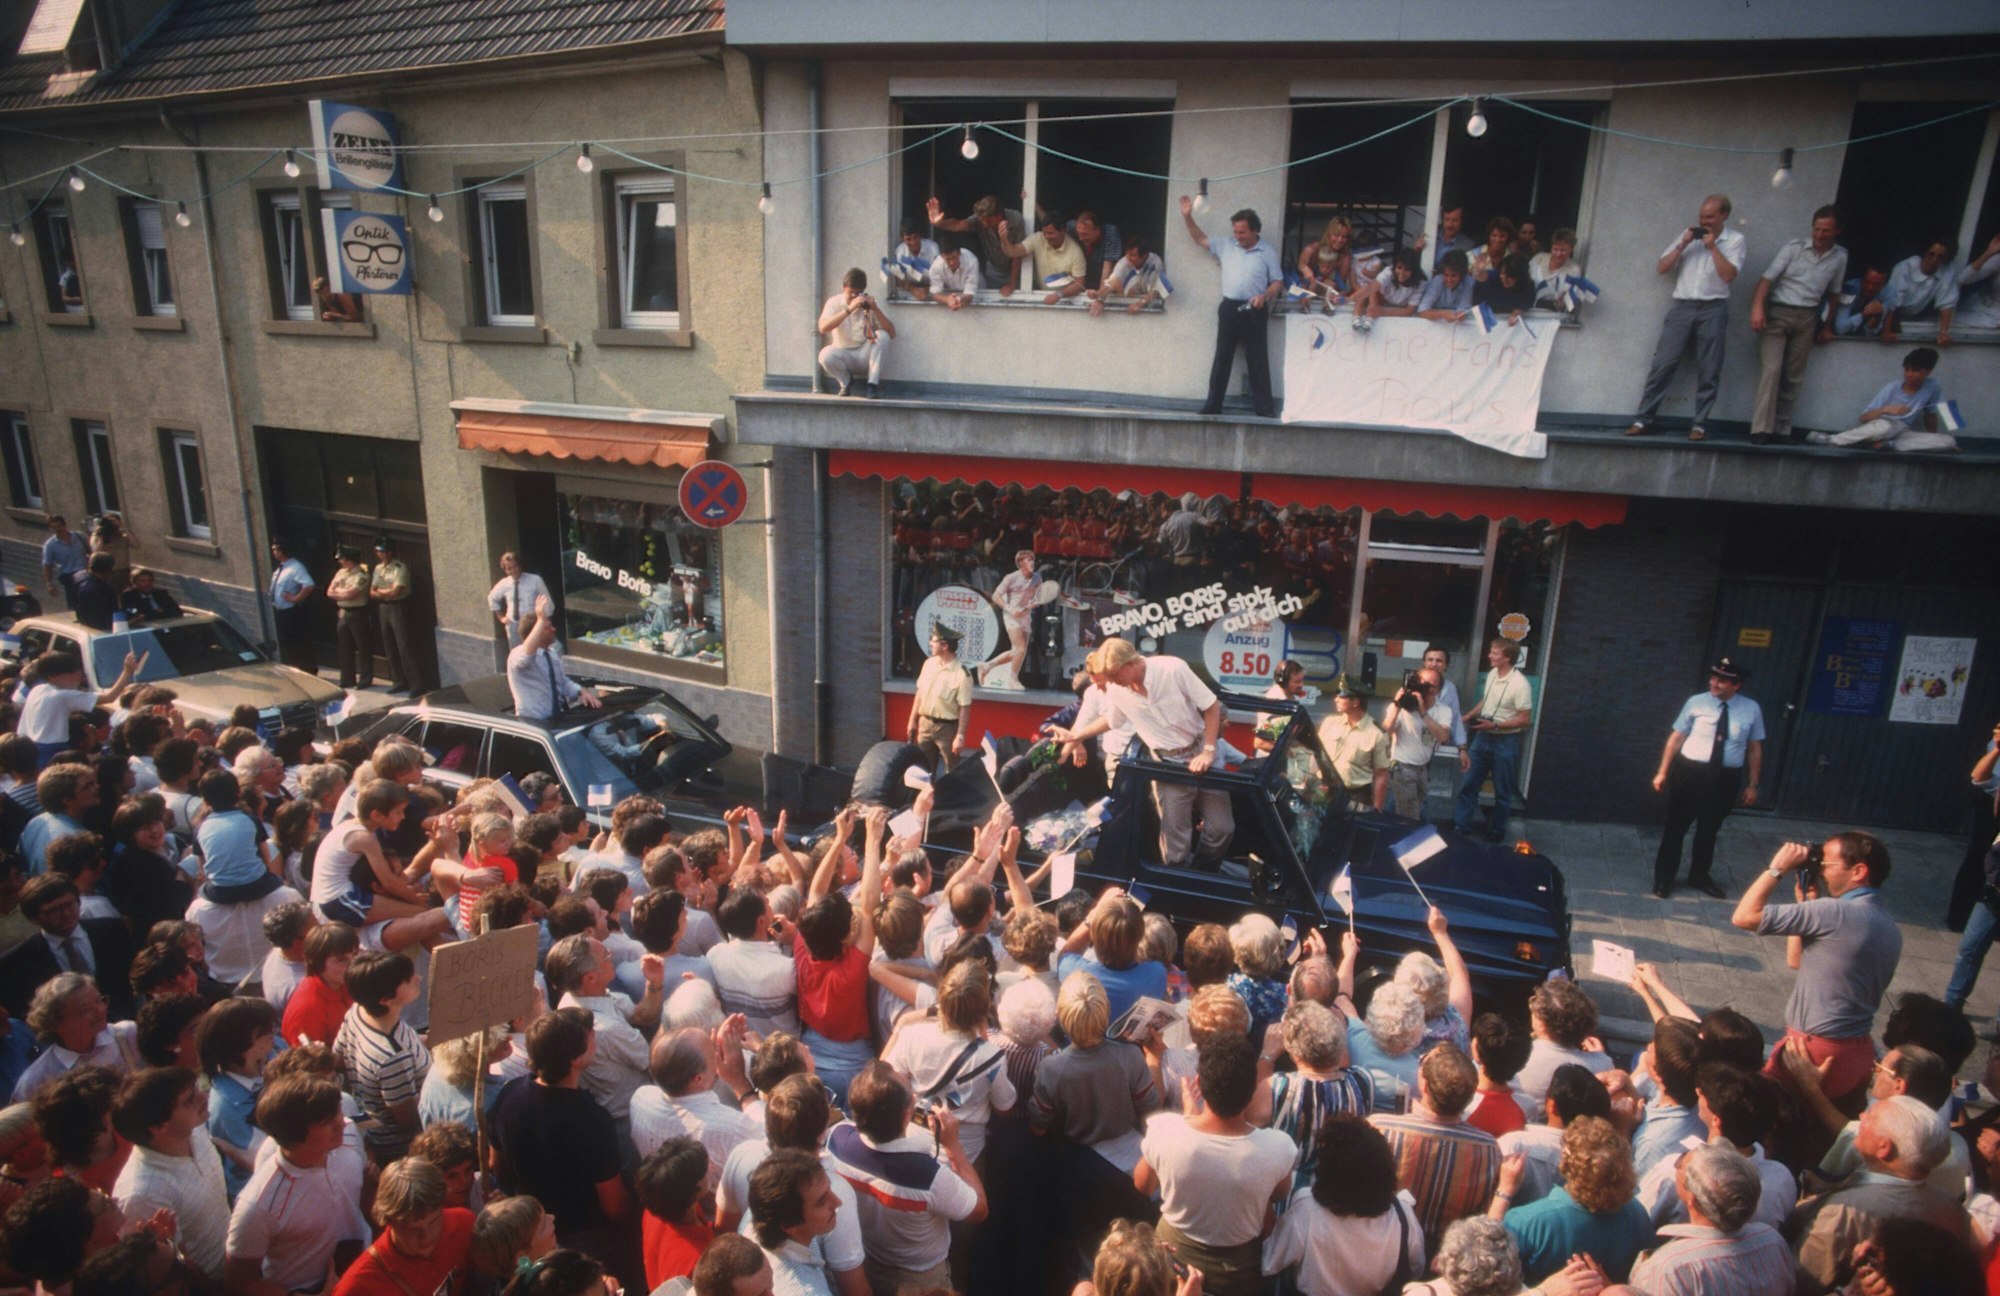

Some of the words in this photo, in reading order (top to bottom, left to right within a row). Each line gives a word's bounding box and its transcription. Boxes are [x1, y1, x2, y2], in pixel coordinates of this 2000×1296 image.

[334, 133, 393, 156] ZEISS
[335, 153, 394, 170] Brillengläser
[354, 225, 390, 241] Optik
[356, 264, 399, 281] Pfisterer
[1299, 317, 1428, 364] Deine
[1447, 322, 1538, 369] Fans
[576, 550, 612, 580] Bravo
[617, 569, 653, 596] Boris
[1100, 602, 1164, 637] BRAVO
[1166, 582, 1227, 617] BORIS
[1146, 616, 1178, 639] wir
[1183, 601, 1224, 628] sind
[1227, 584, 1275, 613] stolz
[1222, 604, 1260, 634] auf
[1261, 591, 1304, 623] dich
[1225, 633, 1270, 648] Anzug
[1220, 651, 1271, 676] 8.50
[444, 945, 505, 978] BORIS
